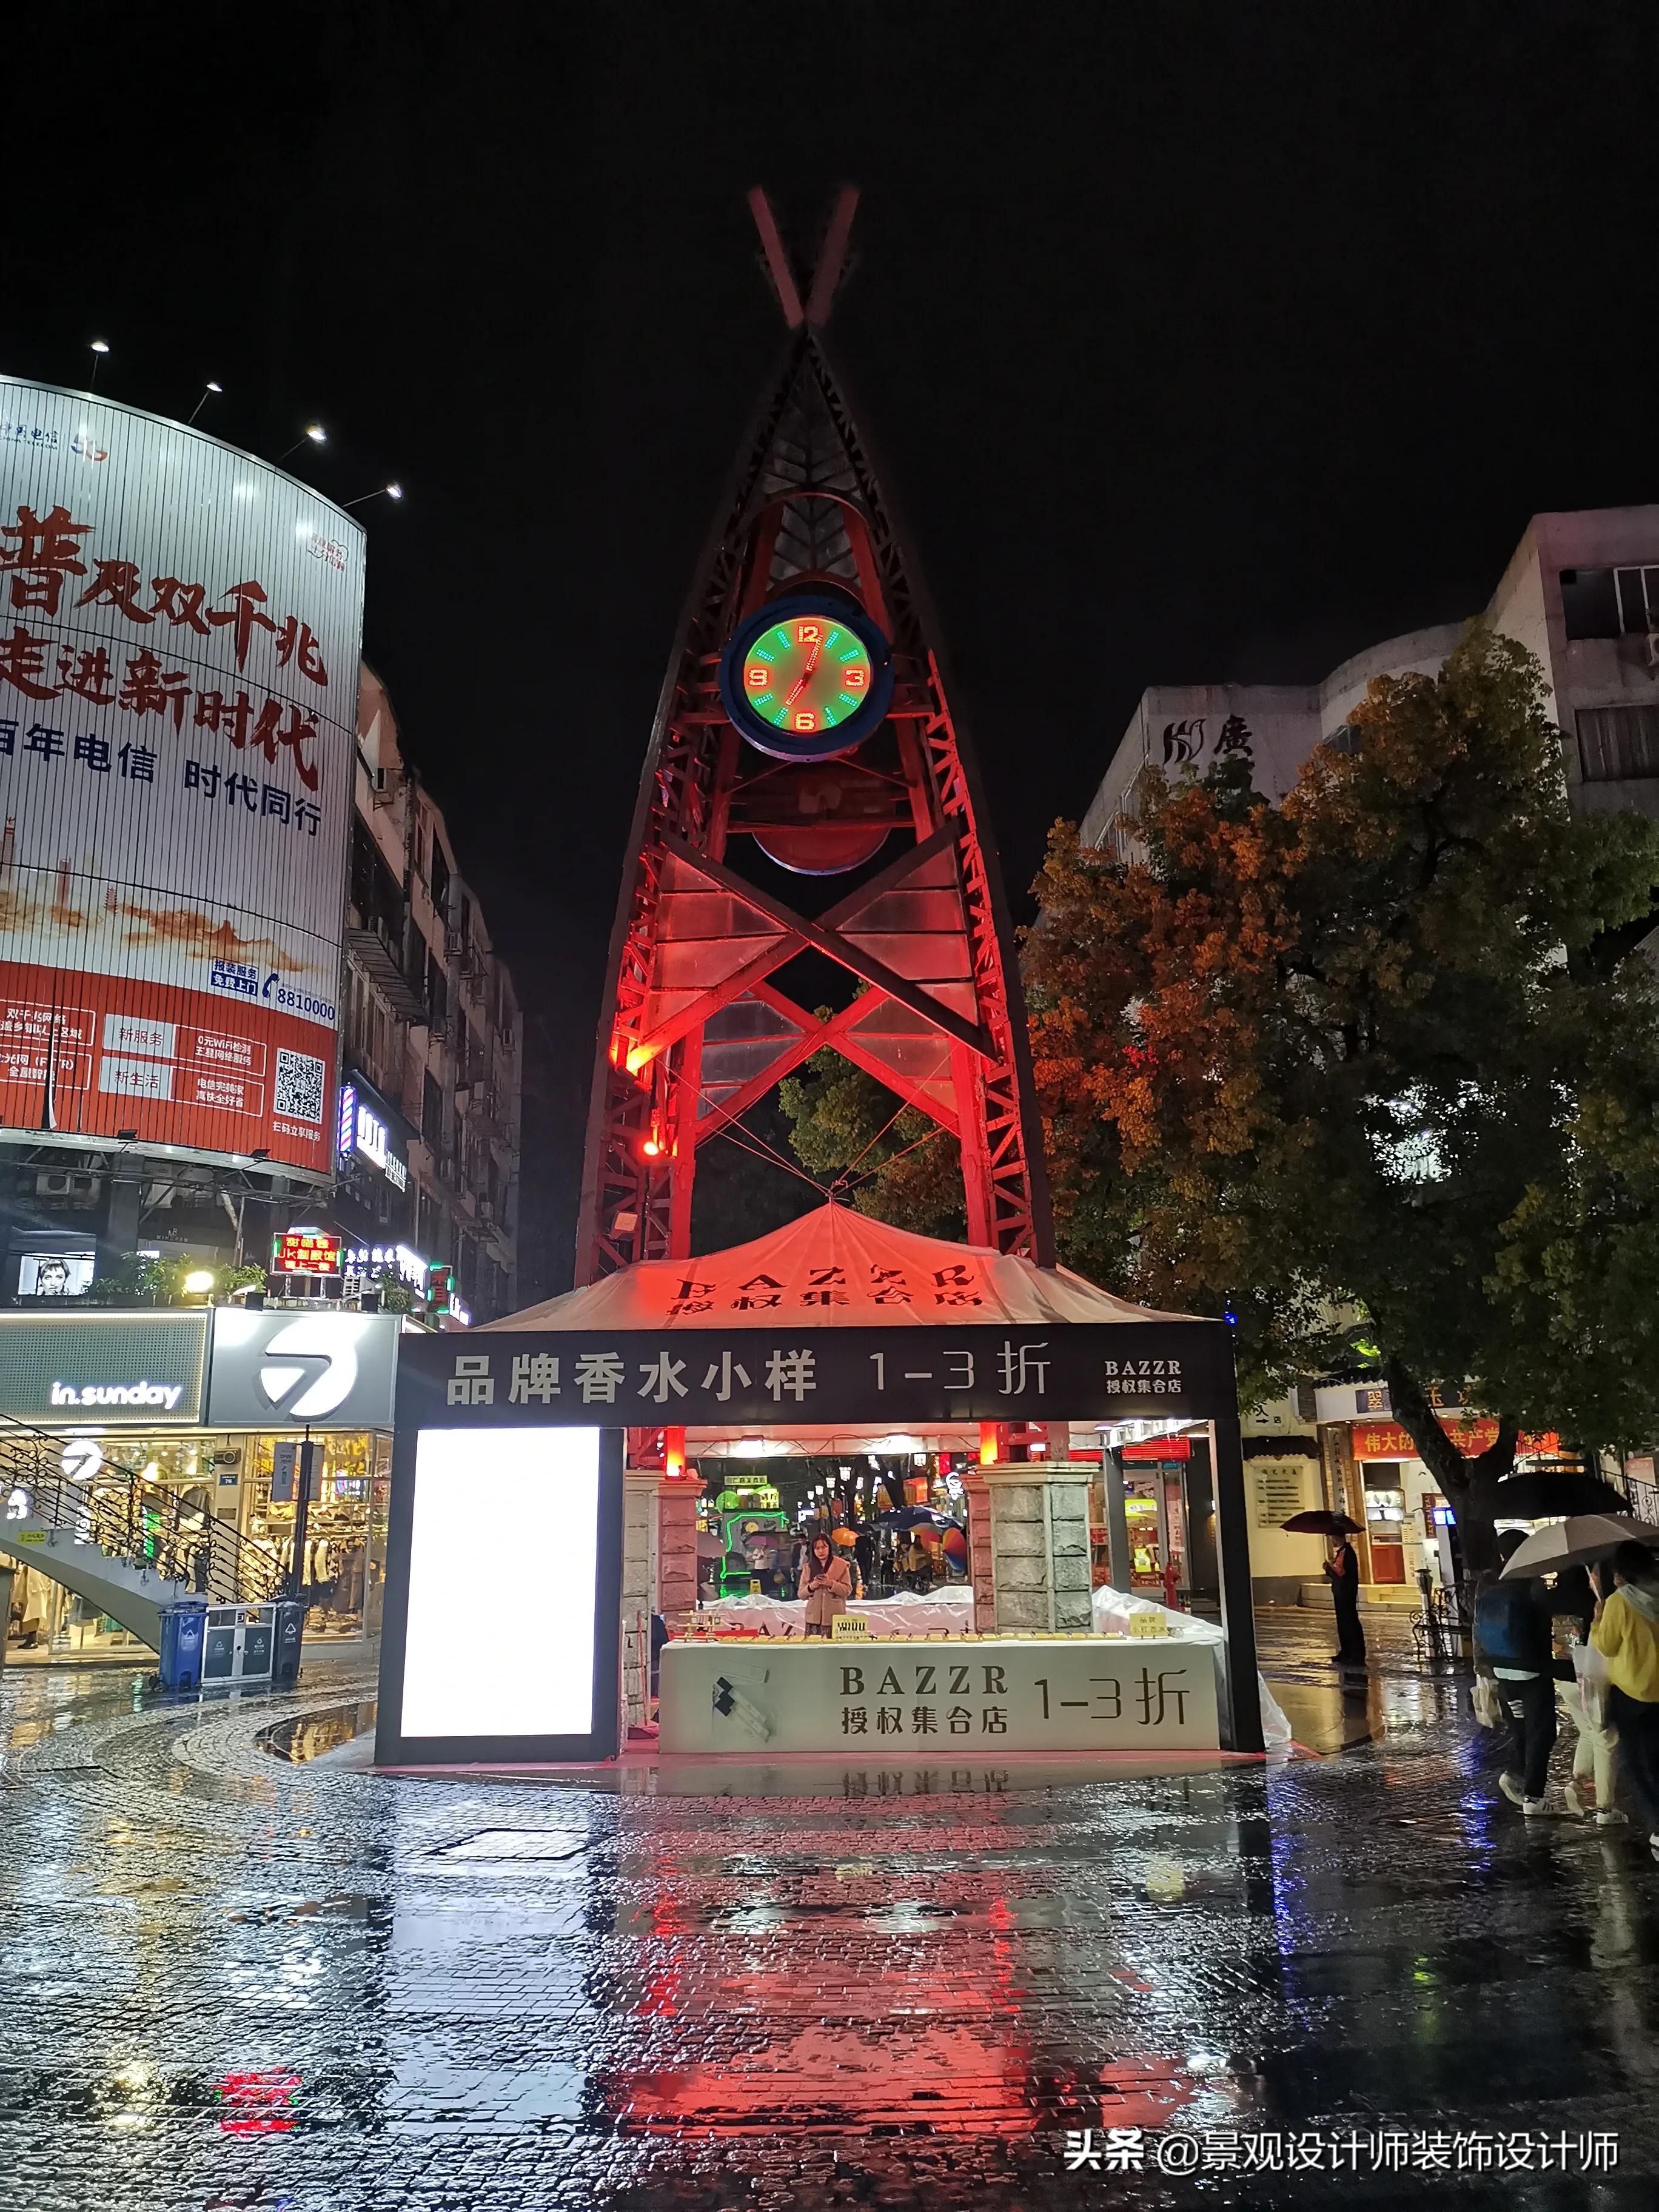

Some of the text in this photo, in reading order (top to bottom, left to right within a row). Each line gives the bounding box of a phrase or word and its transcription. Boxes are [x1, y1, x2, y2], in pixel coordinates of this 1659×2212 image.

[0, 506, 328, 686] 普及双千兆
[798, 626, 820, 643] 12
[749, 669, 768, 686] 9
[846, 669, 865, 686] 3
[0, 626, 319, 791] 走进新时代
[795, 712, 816, 730] 6
[185, 760, 321, 836] 时代同行
[214, 959, 258, 982] 报装服务
[213, 974, 258, 995] 免费上门
[278, 988, 335, 1021] 8810000
[119, 1027, 163, 1046] 新服务
[115, 1071, 159, 1089] 新生活
[447, 1349, 817, 1406] 品牌香水小样
[1105, 1361, 1182, 1376] BAZZR
[51, 1381, 182, 1409] in.sunday
[1107, 1379, 1182, 1393] 授权集合店
[840, 1666, 1008, 1695] BAZZR
[842, 1706, 1008, 1734] 授权集合店
